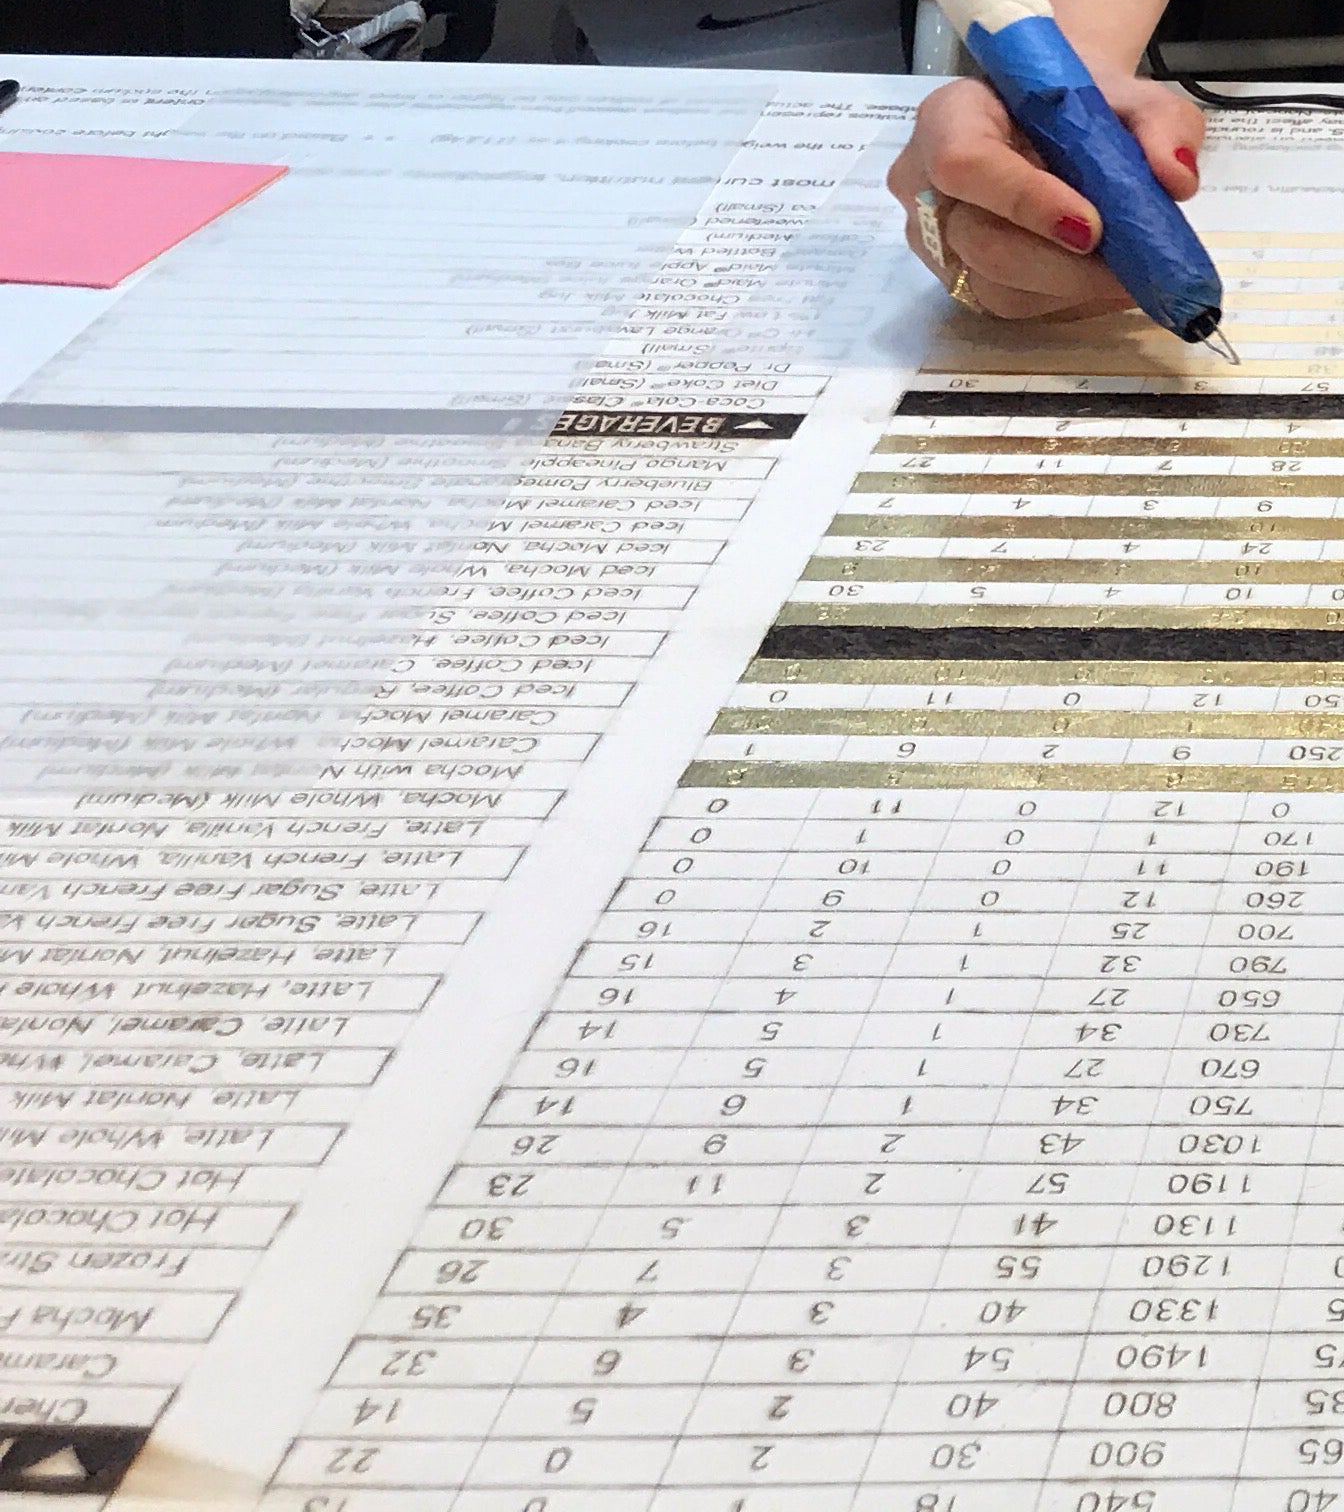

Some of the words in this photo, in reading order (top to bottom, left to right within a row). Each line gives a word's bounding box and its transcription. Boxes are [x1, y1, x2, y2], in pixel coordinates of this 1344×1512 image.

[485, 1171, 537, 1199] 23
[684, 1171, 726, 1197] 11
[861, 1171, 887, 1197] 2
[1023, 1170, 1070, 1196] 57
[1165, 1170, 1254, 1197] 1190
[378, 1347, 439, 1377] 32
[591, 1347, 623, 1377] 6
[786, 1347, 816, 1376] 3
[962, 1343, 1015, 1373] 54
[1114, 1341, 1207, 1371] 1490
